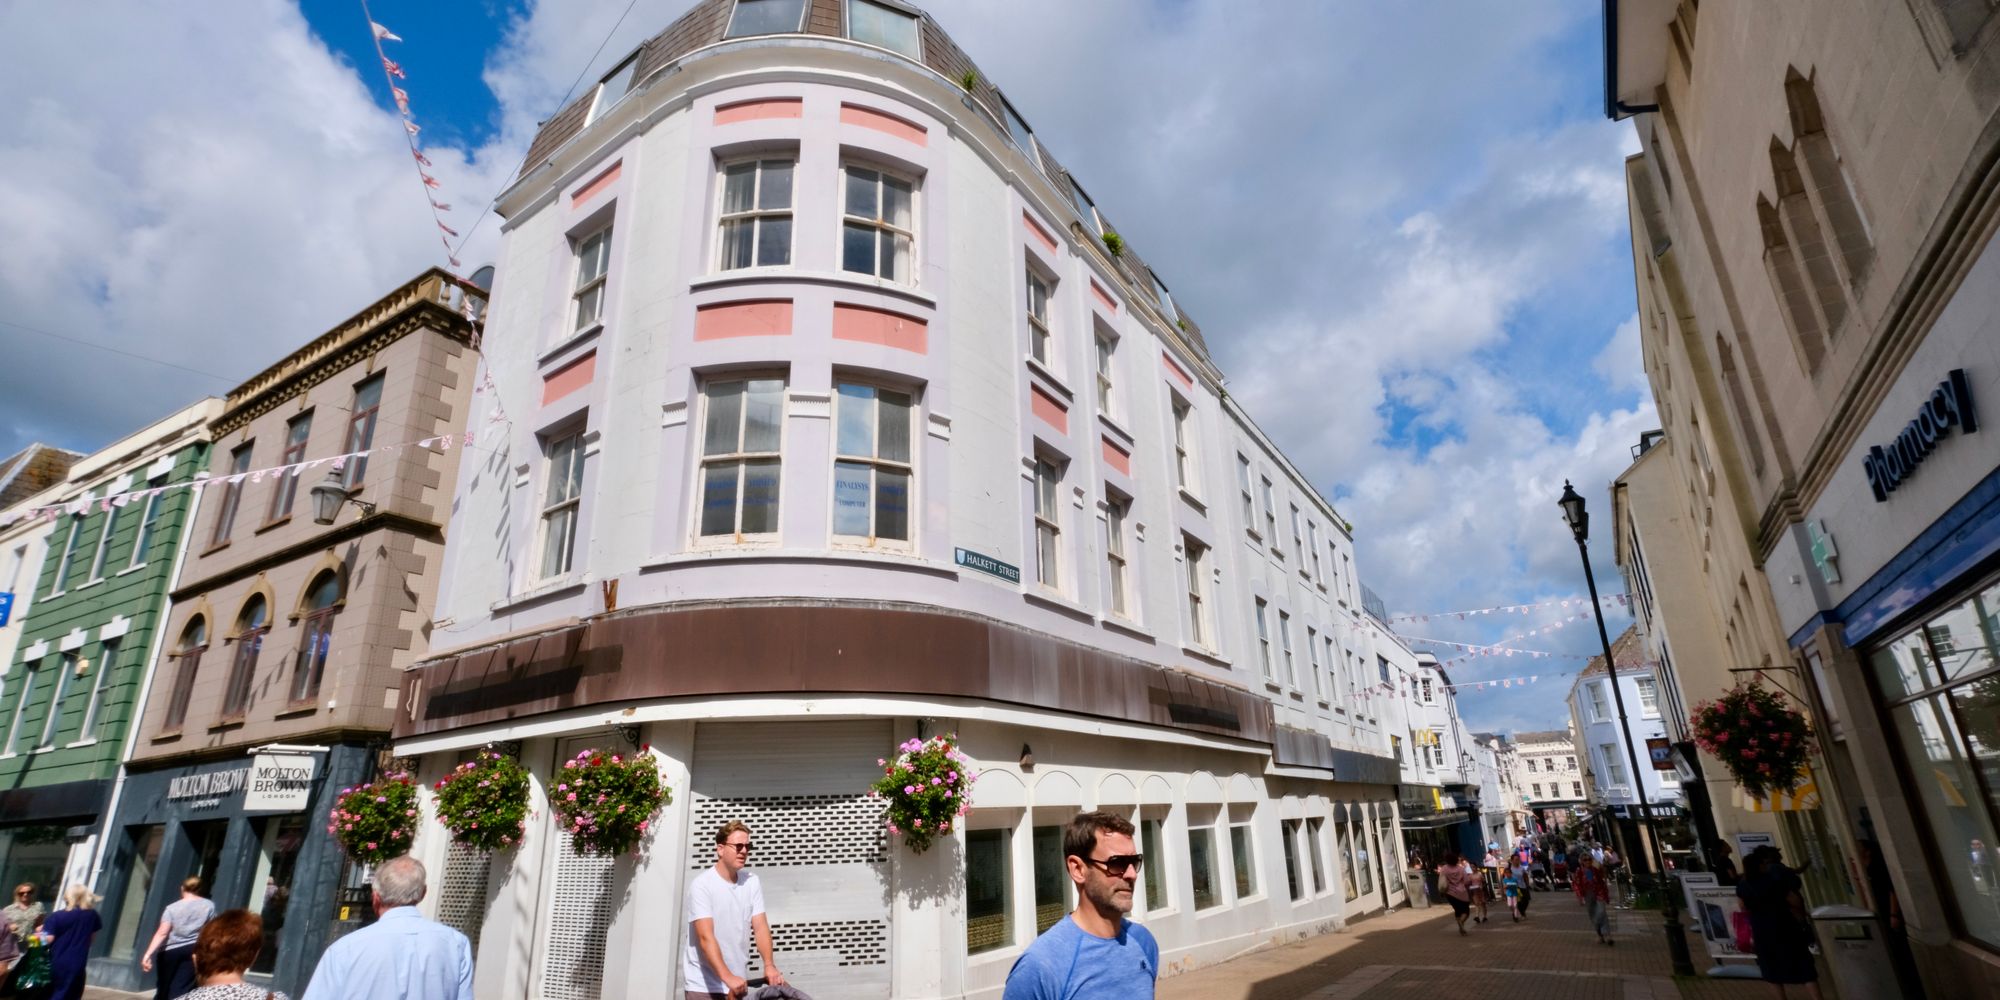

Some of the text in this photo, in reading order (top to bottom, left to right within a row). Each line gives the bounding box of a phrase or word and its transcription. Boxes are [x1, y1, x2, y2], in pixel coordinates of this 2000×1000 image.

[1862, 368, 1977, 503] Pharmacy
[966, 553, 1020, 580] HALKETT STREET
[167, 773, 211, 798] MOLTON
[253, 779, 309, 793] BROWN
[256, 767, 311, 780] MOLTON
